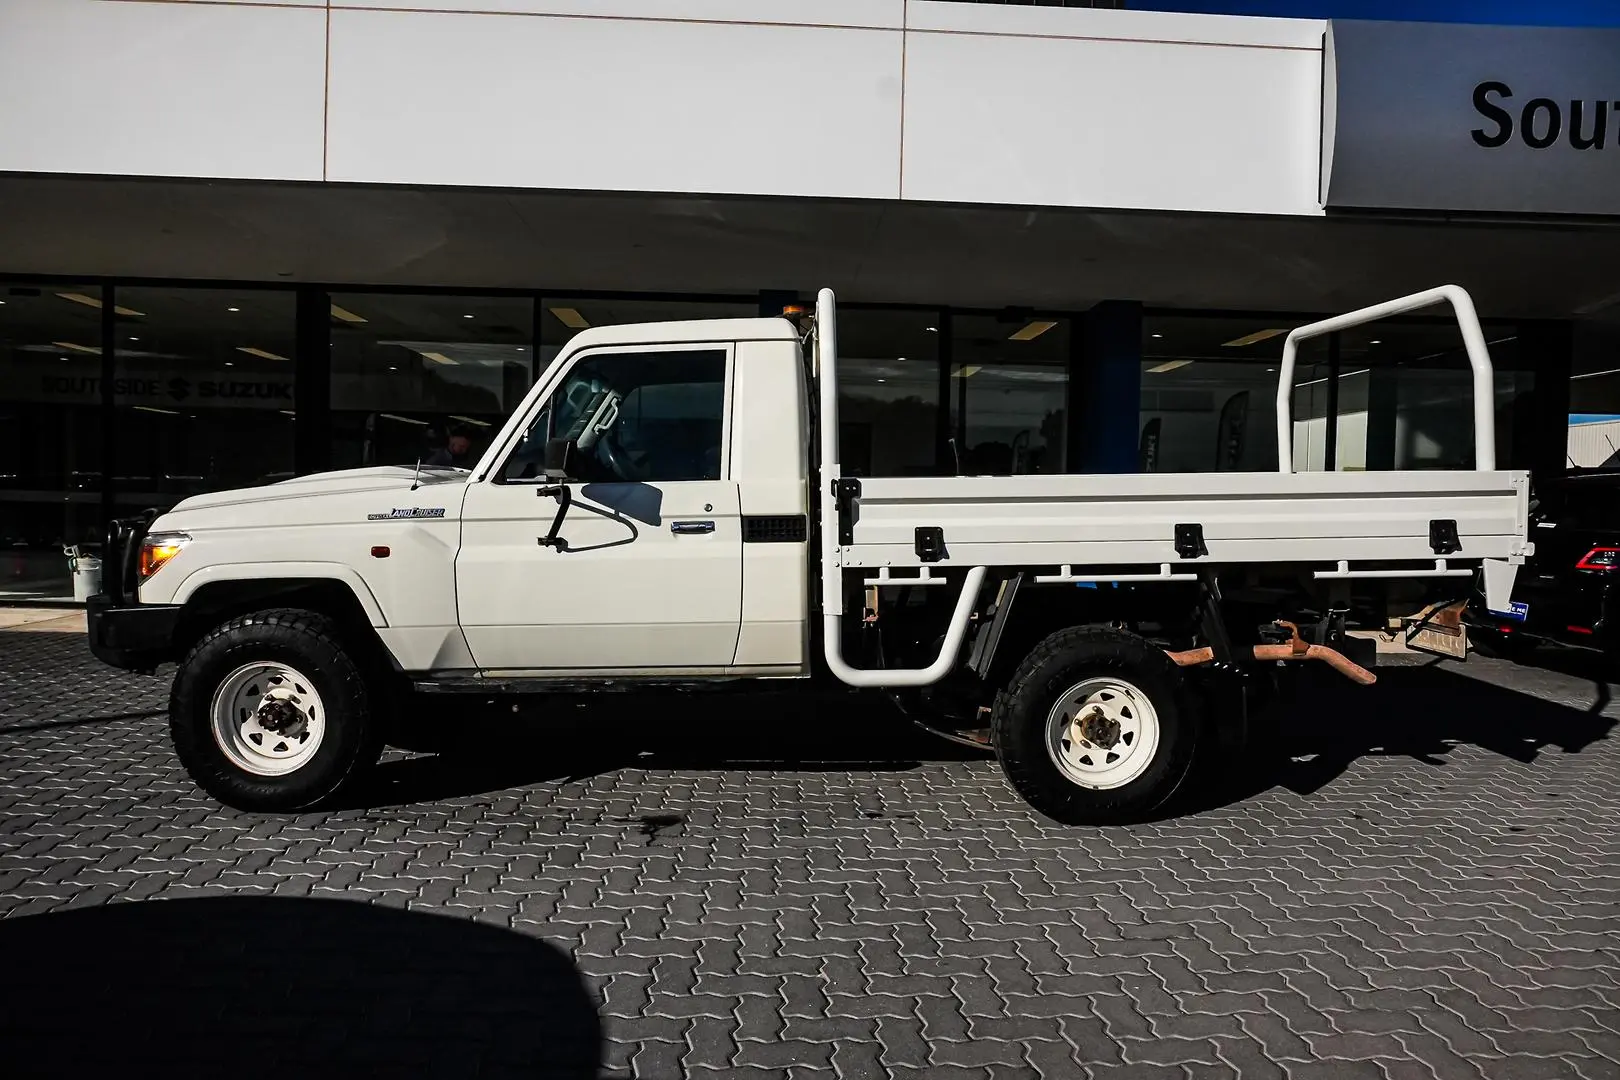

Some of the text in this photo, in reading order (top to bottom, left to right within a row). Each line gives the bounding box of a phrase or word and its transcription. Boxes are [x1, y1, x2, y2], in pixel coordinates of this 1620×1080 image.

[1470, 81, 1620, 150] Sou
[42, 375, 292, 399] SOUTSIDE SUZUK
